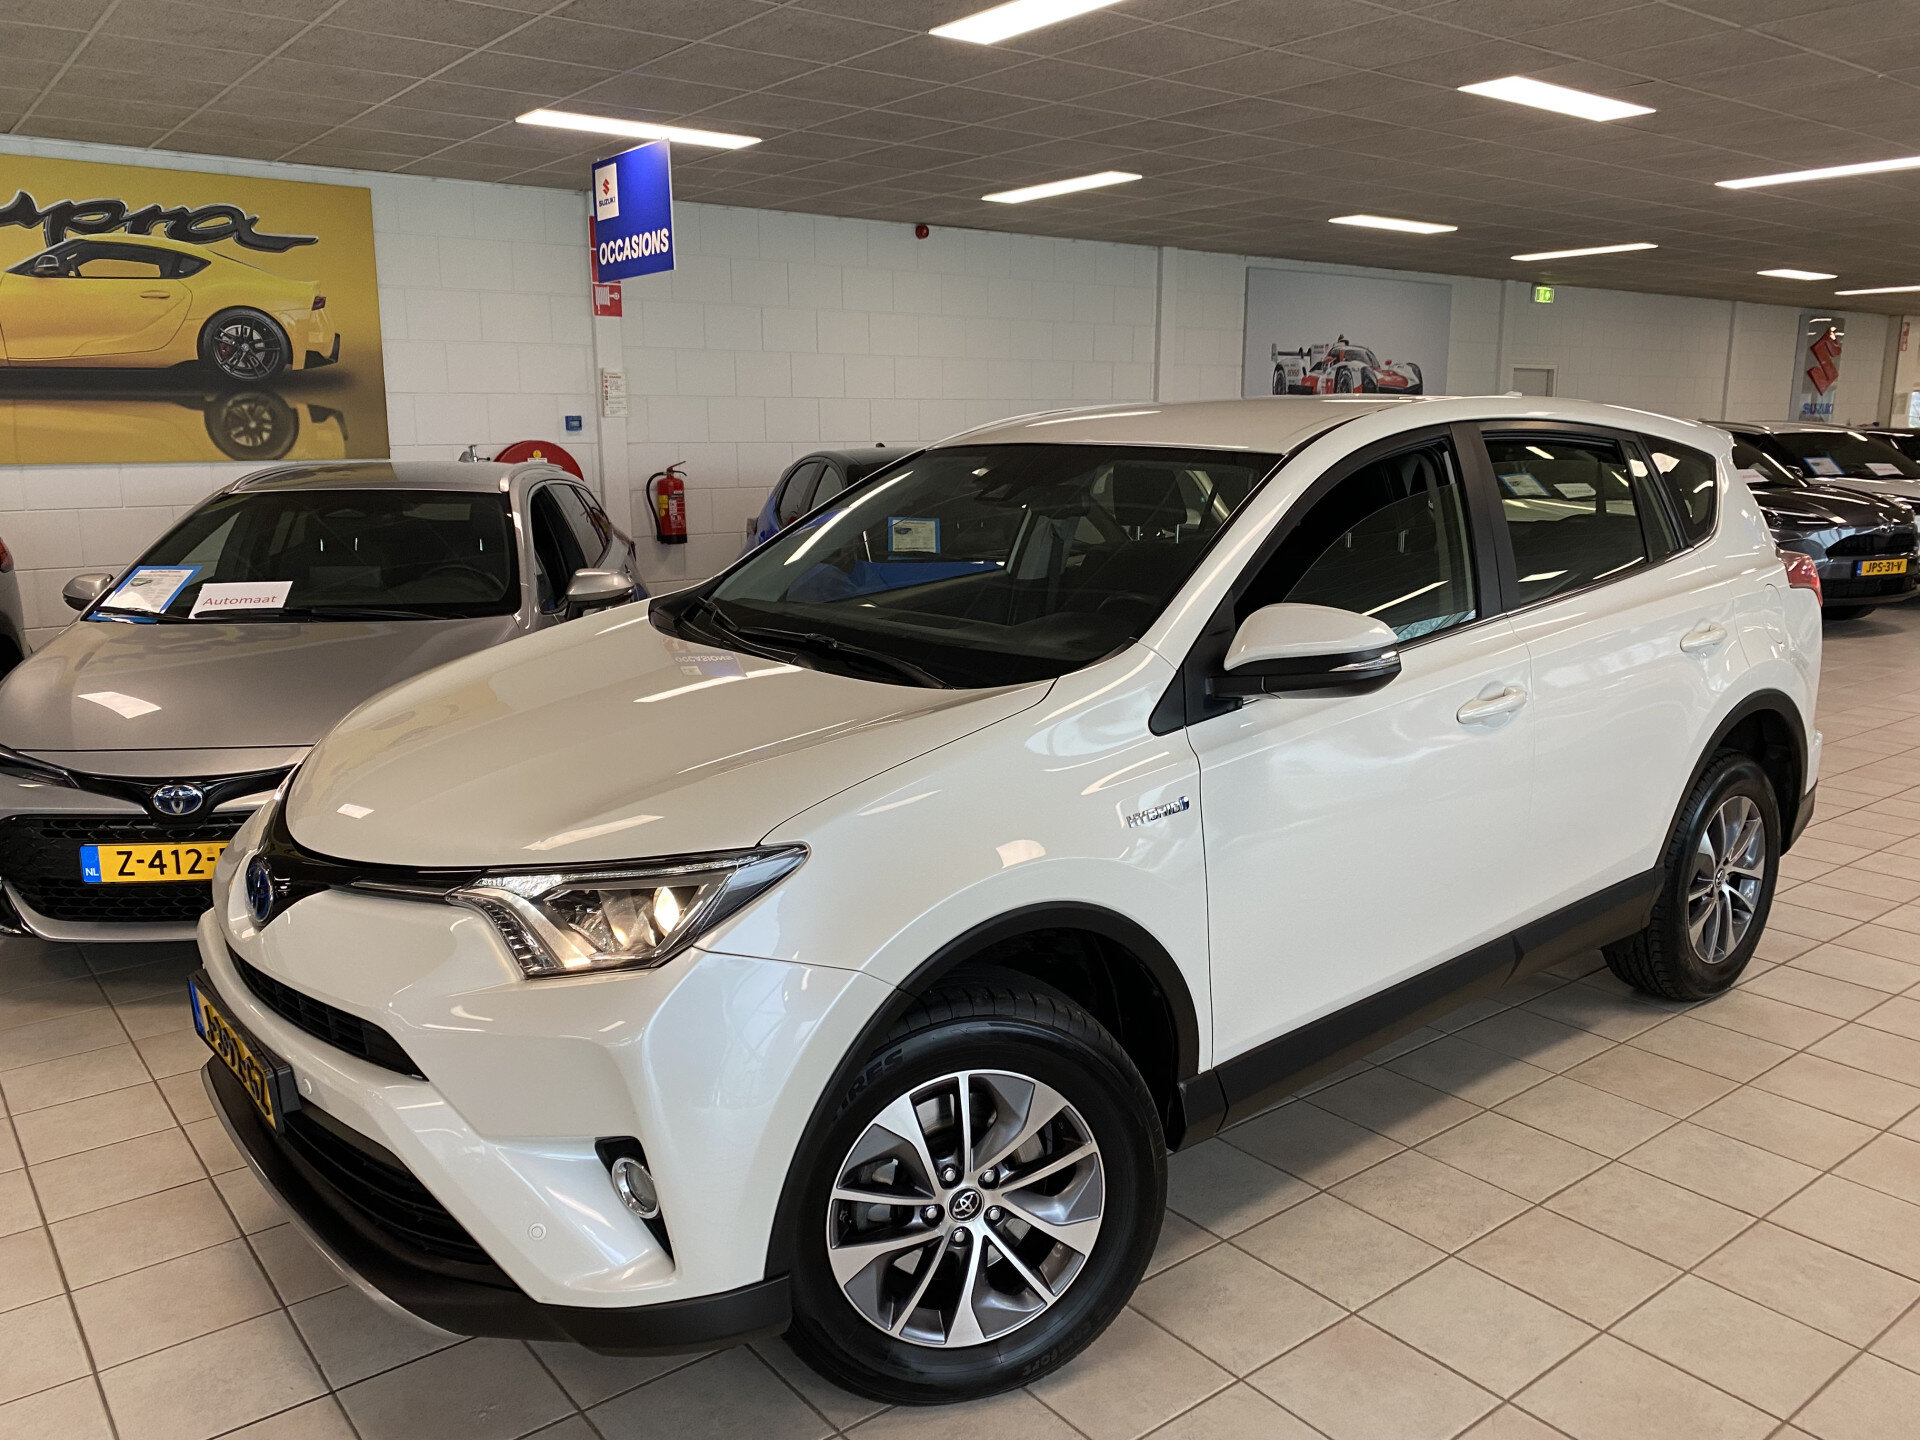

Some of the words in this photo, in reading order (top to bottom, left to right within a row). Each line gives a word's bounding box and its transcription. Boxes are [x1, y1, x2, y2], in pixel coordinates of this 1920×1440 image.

[598, 196, 616, 207] SUZUKI
[599, 228, 670, 265] OCCASIONS
[1866, 561, 1903, 573] JPS-31-V
[202, 595, 278, 606] Automaat
[1126, 800, 1181, 829] HYBRID
[85, 867, 100, 877] NL
[116, 848, 226, 876] Z-412-
[833, 1047, 904, 1121] IRES
